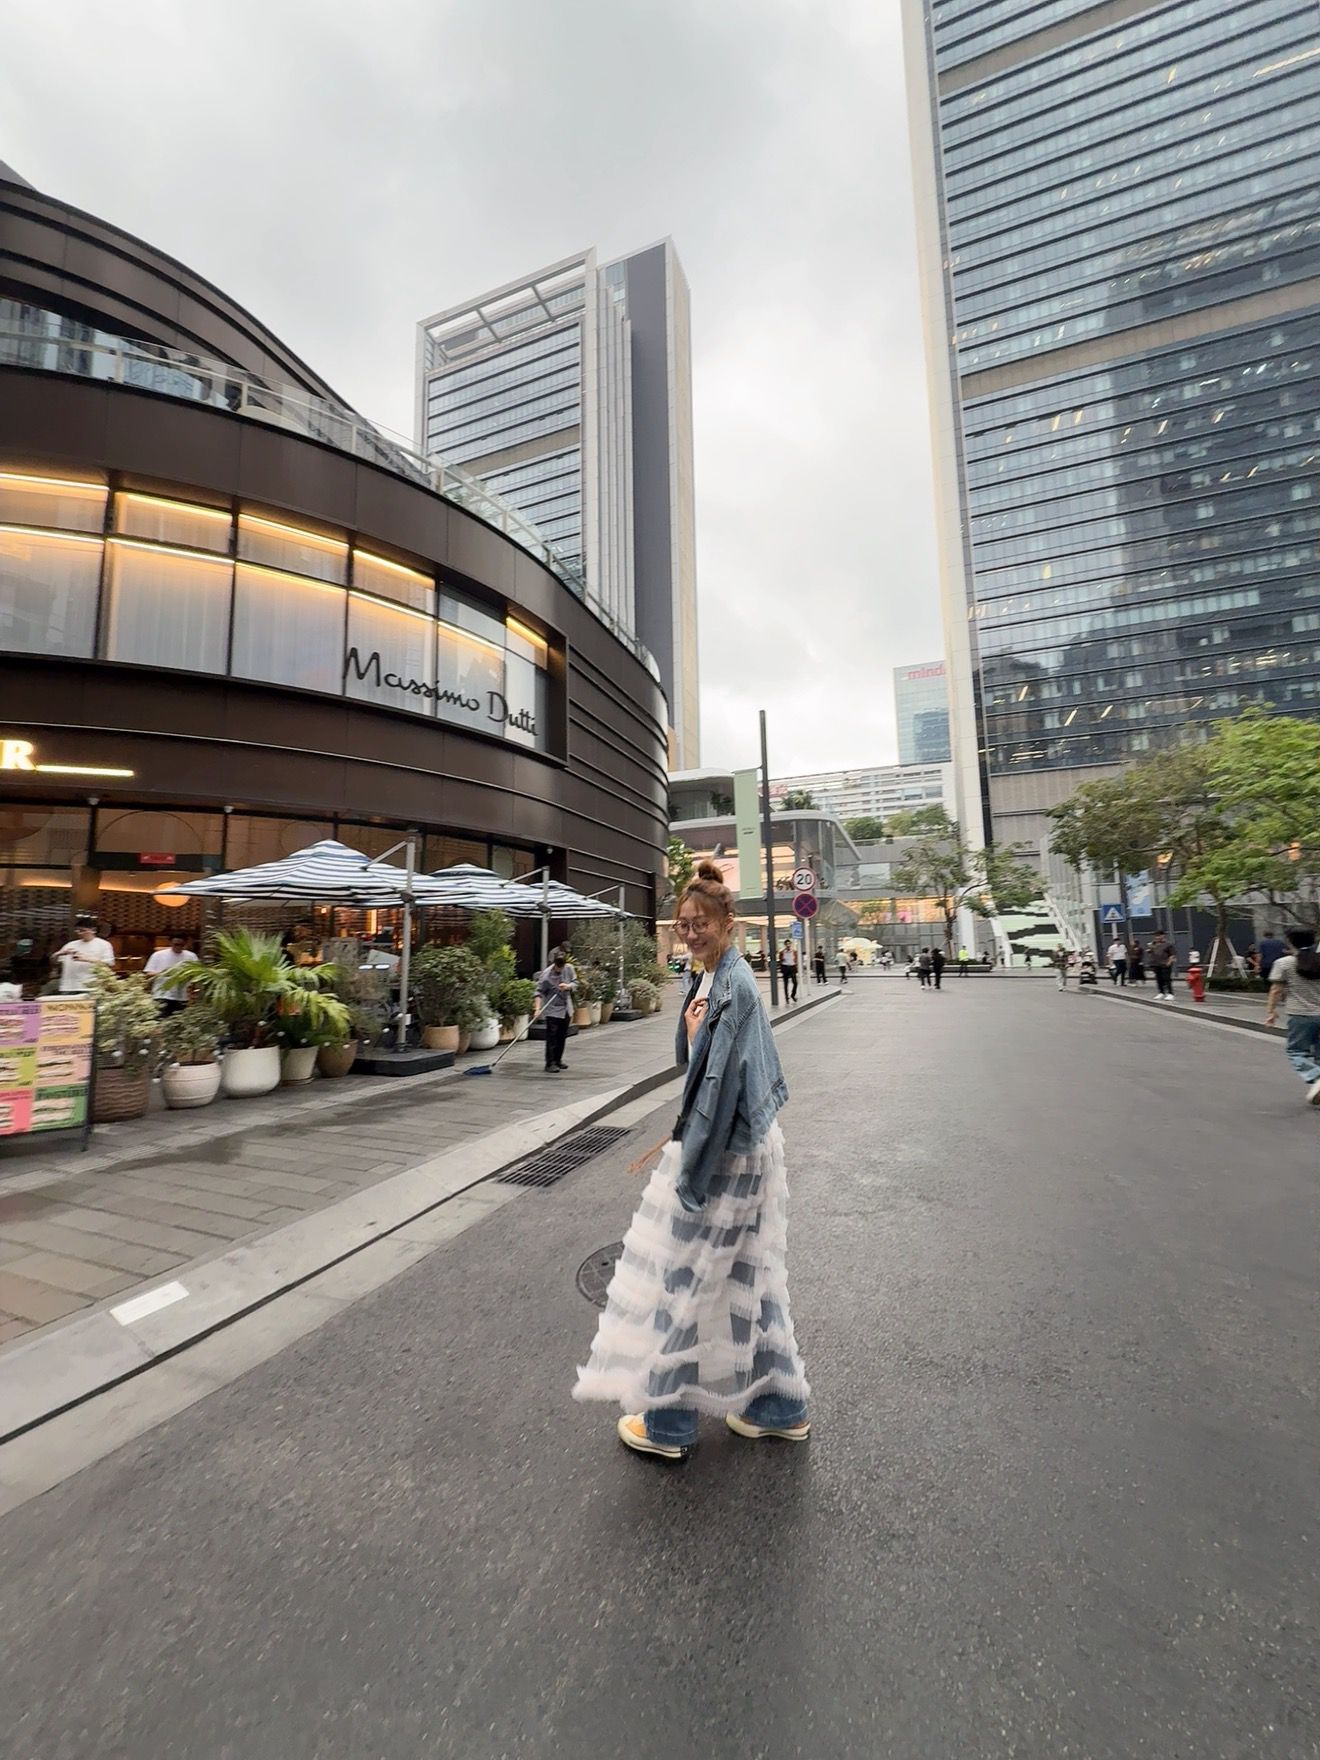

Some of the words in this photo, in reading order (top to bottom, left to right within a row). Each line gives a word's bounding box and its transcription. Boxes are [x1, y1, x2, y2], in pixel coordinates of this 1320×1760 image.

[908, 664, 945, 680] mind
[342, 647, 480, 711] Massimo
[487, 690, 539, 736] Dutti
[796, 873, 812, 885] 20
